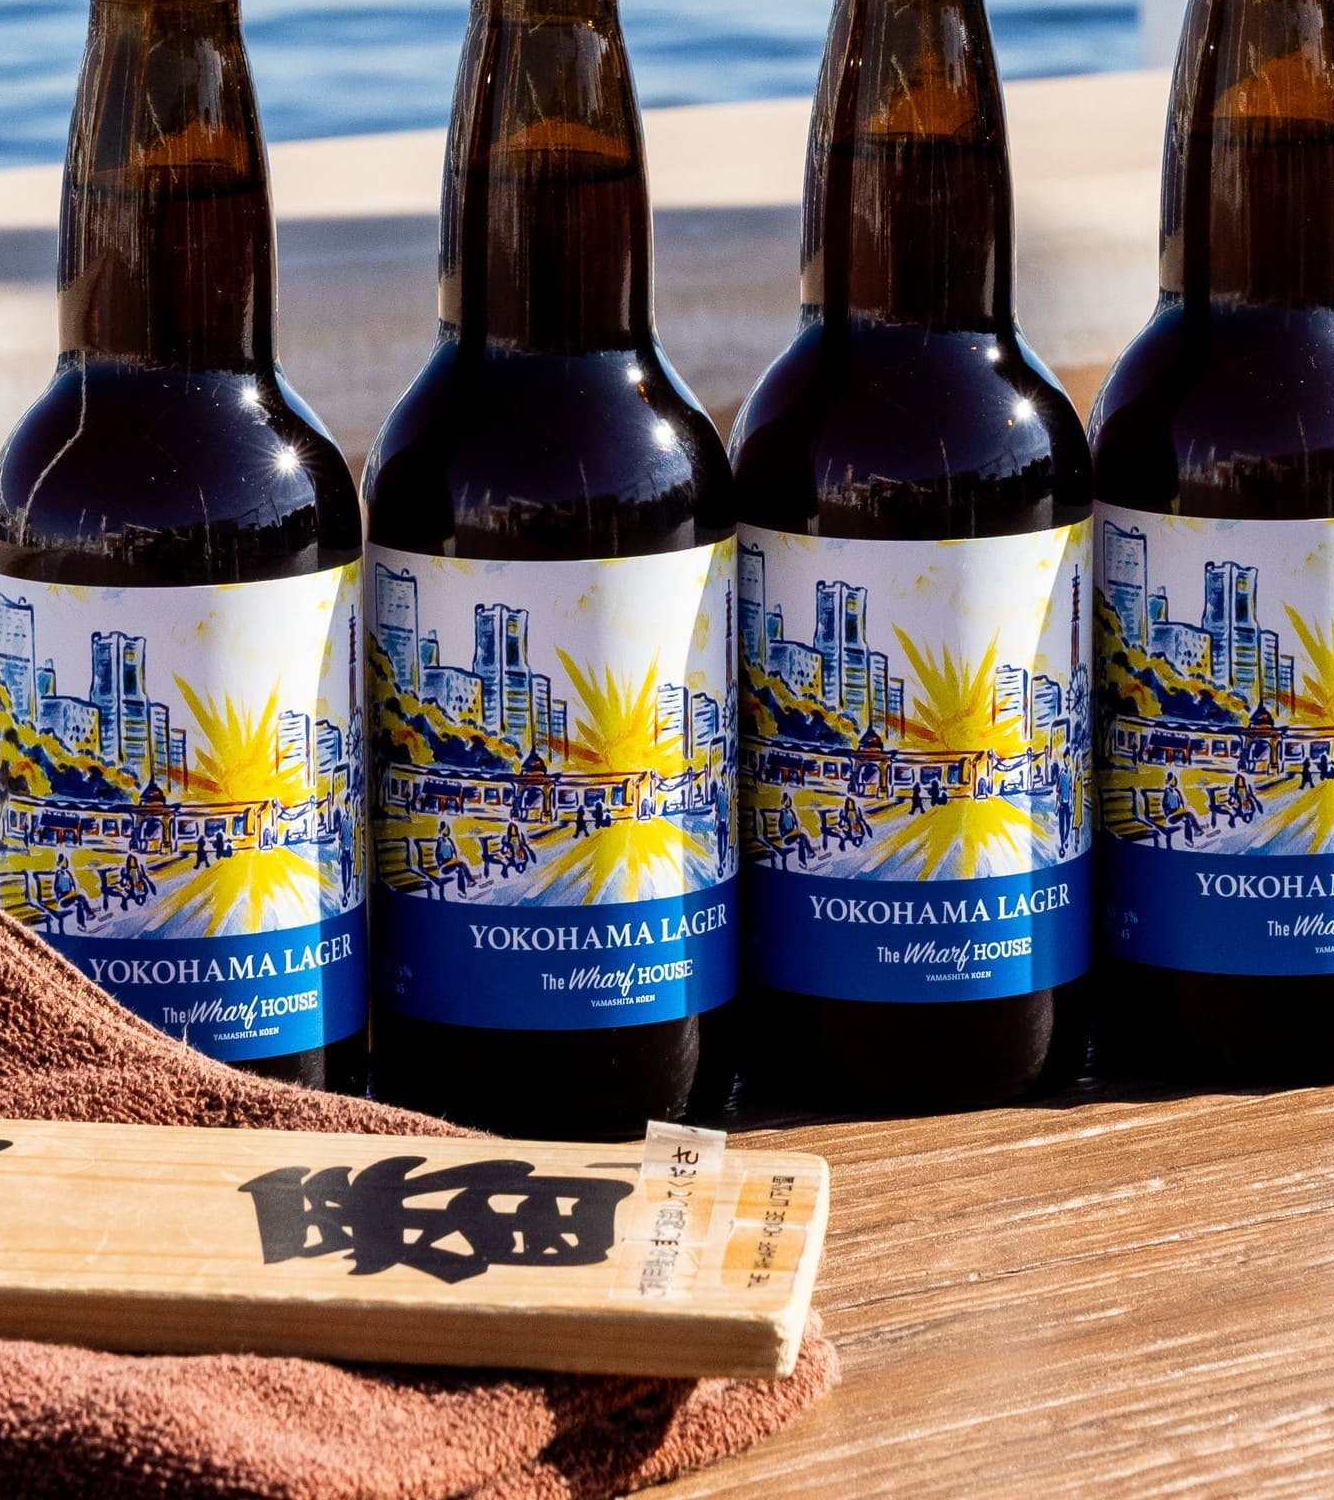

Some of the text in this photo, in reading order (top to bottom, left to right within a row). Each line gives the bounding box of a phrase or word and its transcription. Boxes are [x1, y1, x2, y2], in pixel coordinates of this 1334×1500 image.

[809, 895, 990, 924] YOKOHAMA
[998, 883, 1070, 920] LAGER
[469, 904, 727, 951] YOKOHAMA LAGER
[1267, 920, 1290, 937] The
[89, 933, 352, 985] YOKOHAMA LAGER
[877, 937, 1032, 971] The Wharf HOUSE
[542, 959, 693, 996] The Wharf HOUSE
[925, 973, 970, 981] YAMASHITA
[164, 990, 318, 1029] The Wharf HOUSE
[591, 997, 634, 1008] YAMASHITA
[214, 1030, 257, 1041] YAMASHITA
